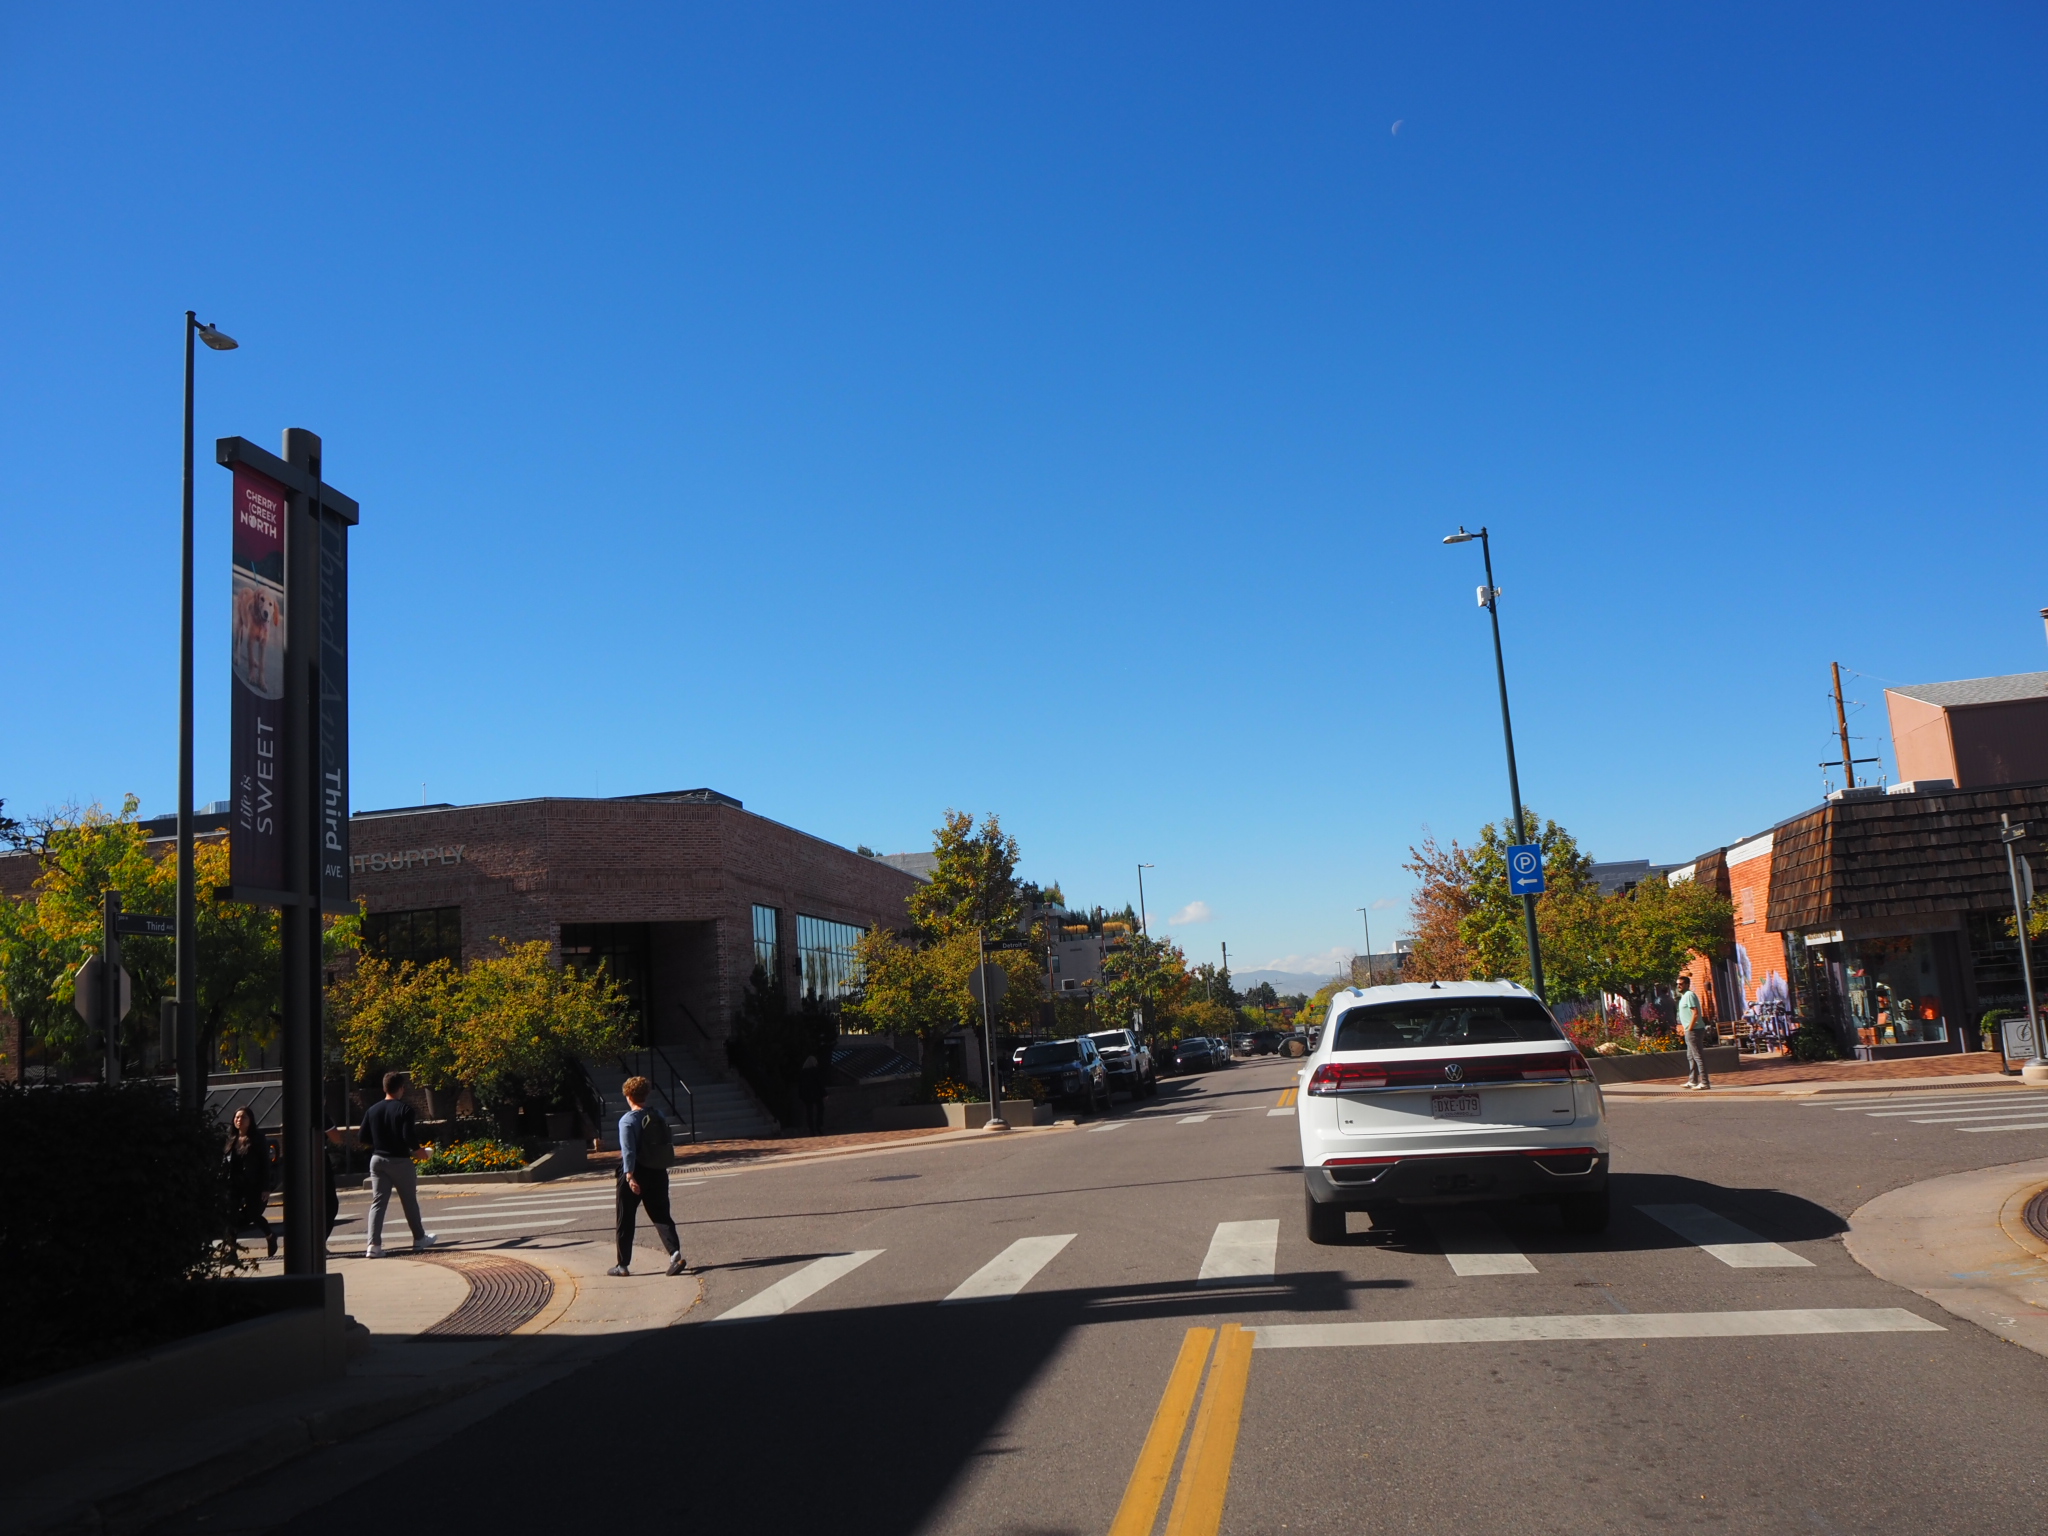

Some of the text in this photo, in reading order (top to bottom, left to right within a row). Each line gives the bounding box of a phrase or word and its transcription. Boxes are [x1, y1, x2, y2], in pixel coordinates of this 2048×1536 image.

[246, 489, 277, 512] CHERRY
[240, 510, 277, 539] NORTH
[251, 503, 277, 524] CREEK
[257, 716, 274, 835] SWEET
[240, 793, 254, 830] Life
[325, 768, 342, 851] Third
[325, 864, 343, 879] AVE.
[1520, 856, 1531, 870] P
[146, 921, 165, 931] Third
[1002, 941, 1022, 949] Detroit
